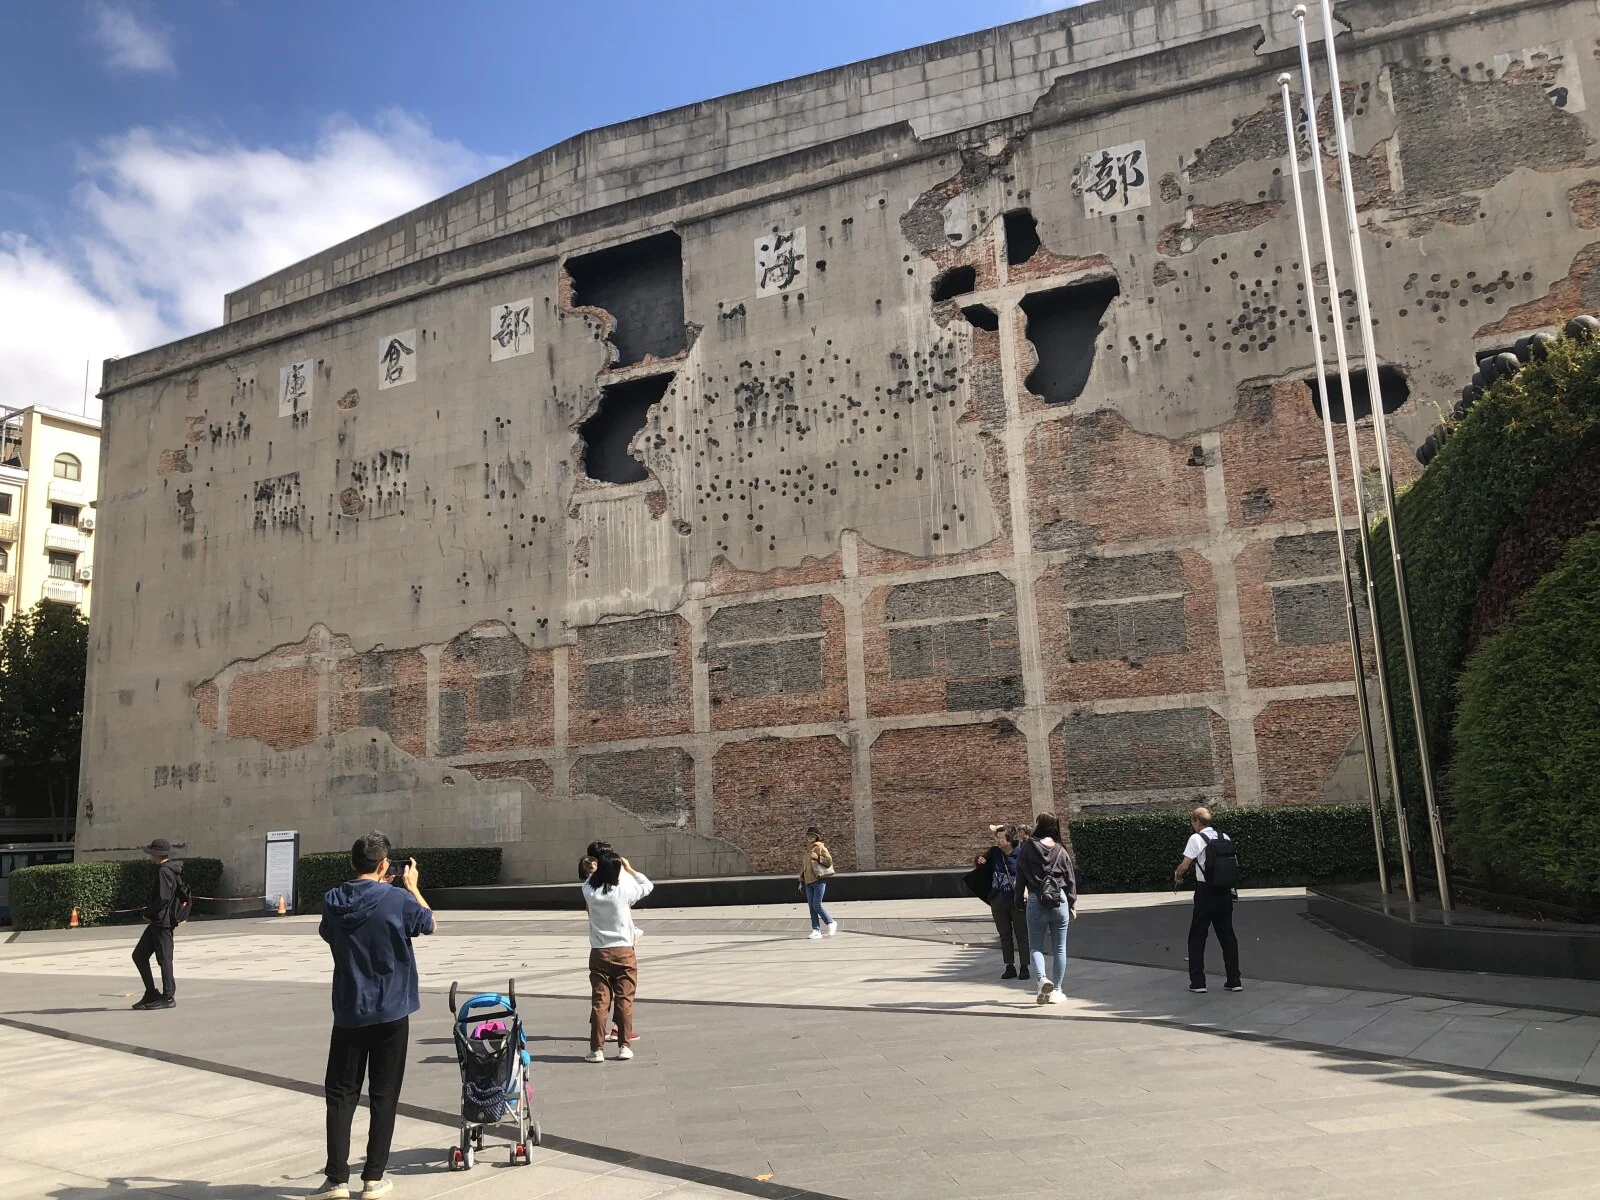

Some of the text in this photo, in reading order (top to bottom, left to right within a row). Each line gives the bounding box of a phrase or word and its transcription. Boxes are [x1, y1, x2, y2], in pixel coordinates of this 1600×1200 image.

[1085, 150, 1145, 207] 部
[758, 231, 805, 290] 海
[492, 305, 531, 353] 部
